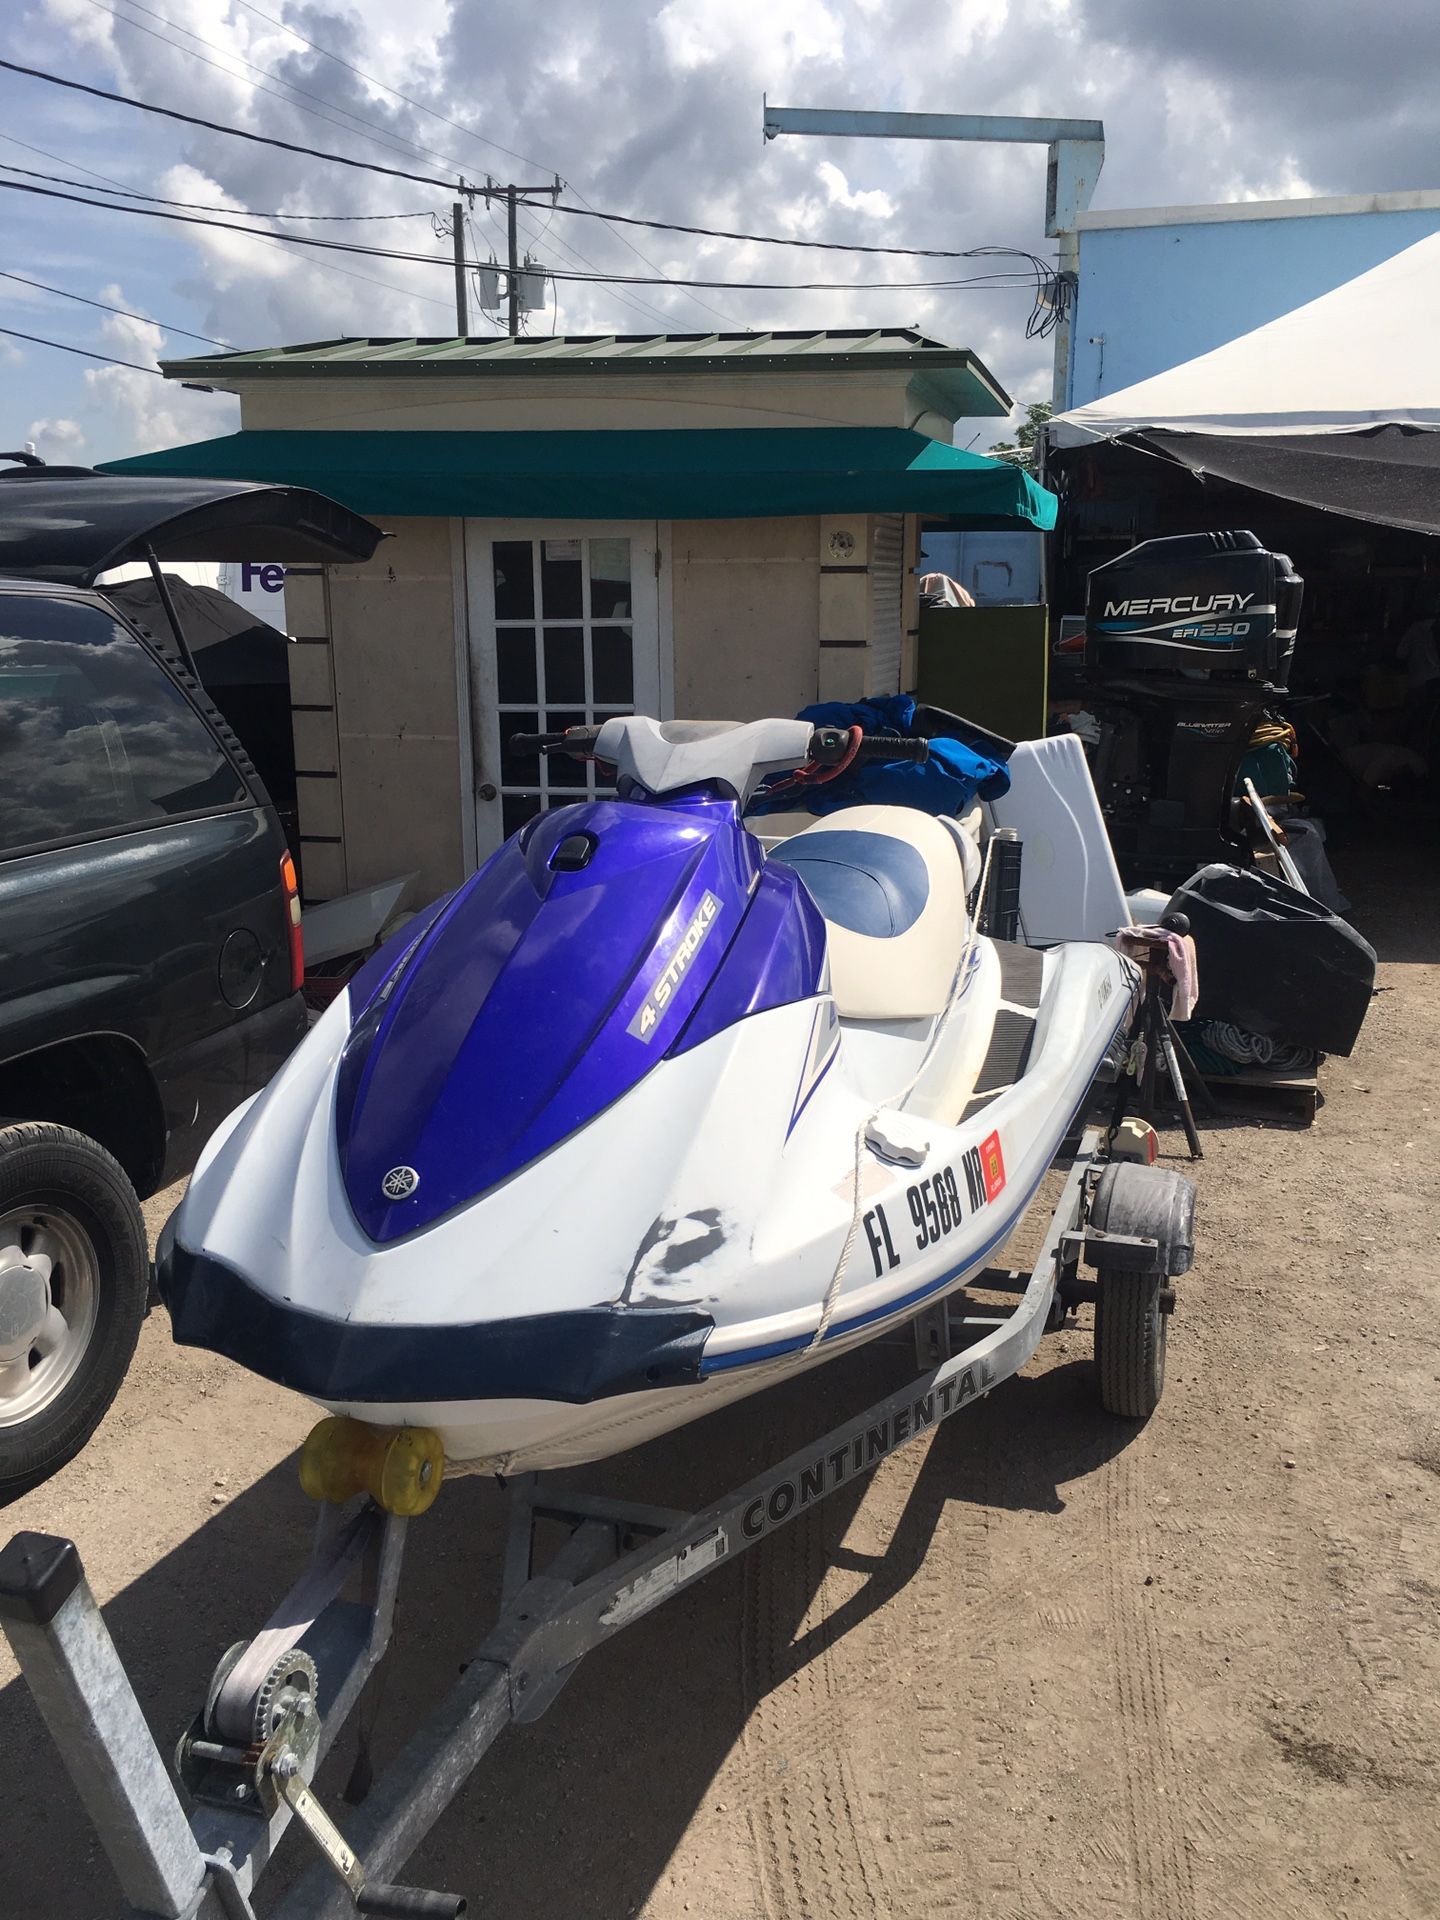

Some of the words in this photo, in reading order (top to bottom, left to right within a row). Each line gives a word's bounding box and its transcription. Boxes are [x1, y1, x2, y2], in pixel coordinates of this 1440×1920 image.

[1103, 592, 1255, 617] MERCURY
[1172, 628, 1200, 639] EFI
[1199, 622, 1251, 637] 250
[640, 1004, 657, 1035] 4
[654, 895, 717, 1009] STROKE
[862, 1203, 901, 1279] FL
[906, 1166, 963, 1251] 9588
[741, 1357, 997, 1540] CONTINENTAL
